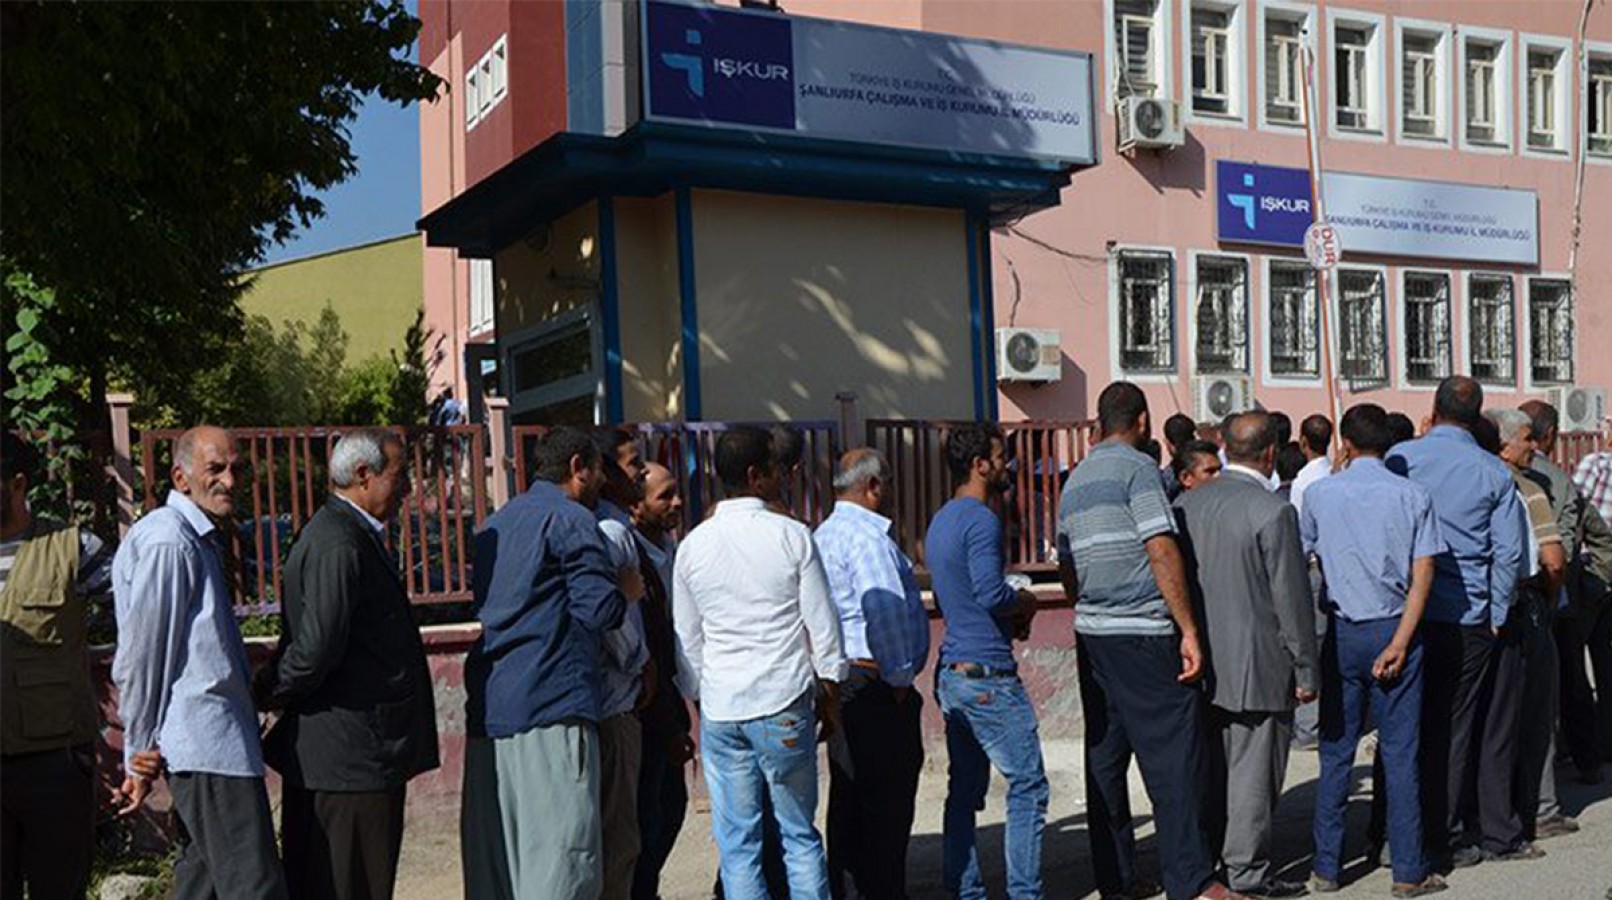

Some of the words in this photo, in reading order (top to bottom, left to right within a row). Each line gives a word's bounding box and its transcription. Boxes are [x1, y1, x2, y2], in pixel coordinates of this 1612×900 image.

[799, 83, 864, 100] ŞANLIURFA
[866, 90, 918, 107] ÇALIŞMA
[920, 97, 934, 110] VE
[950, 100, 998, 117] KURUMU
[1322, 228, 1335, 263] DUR
